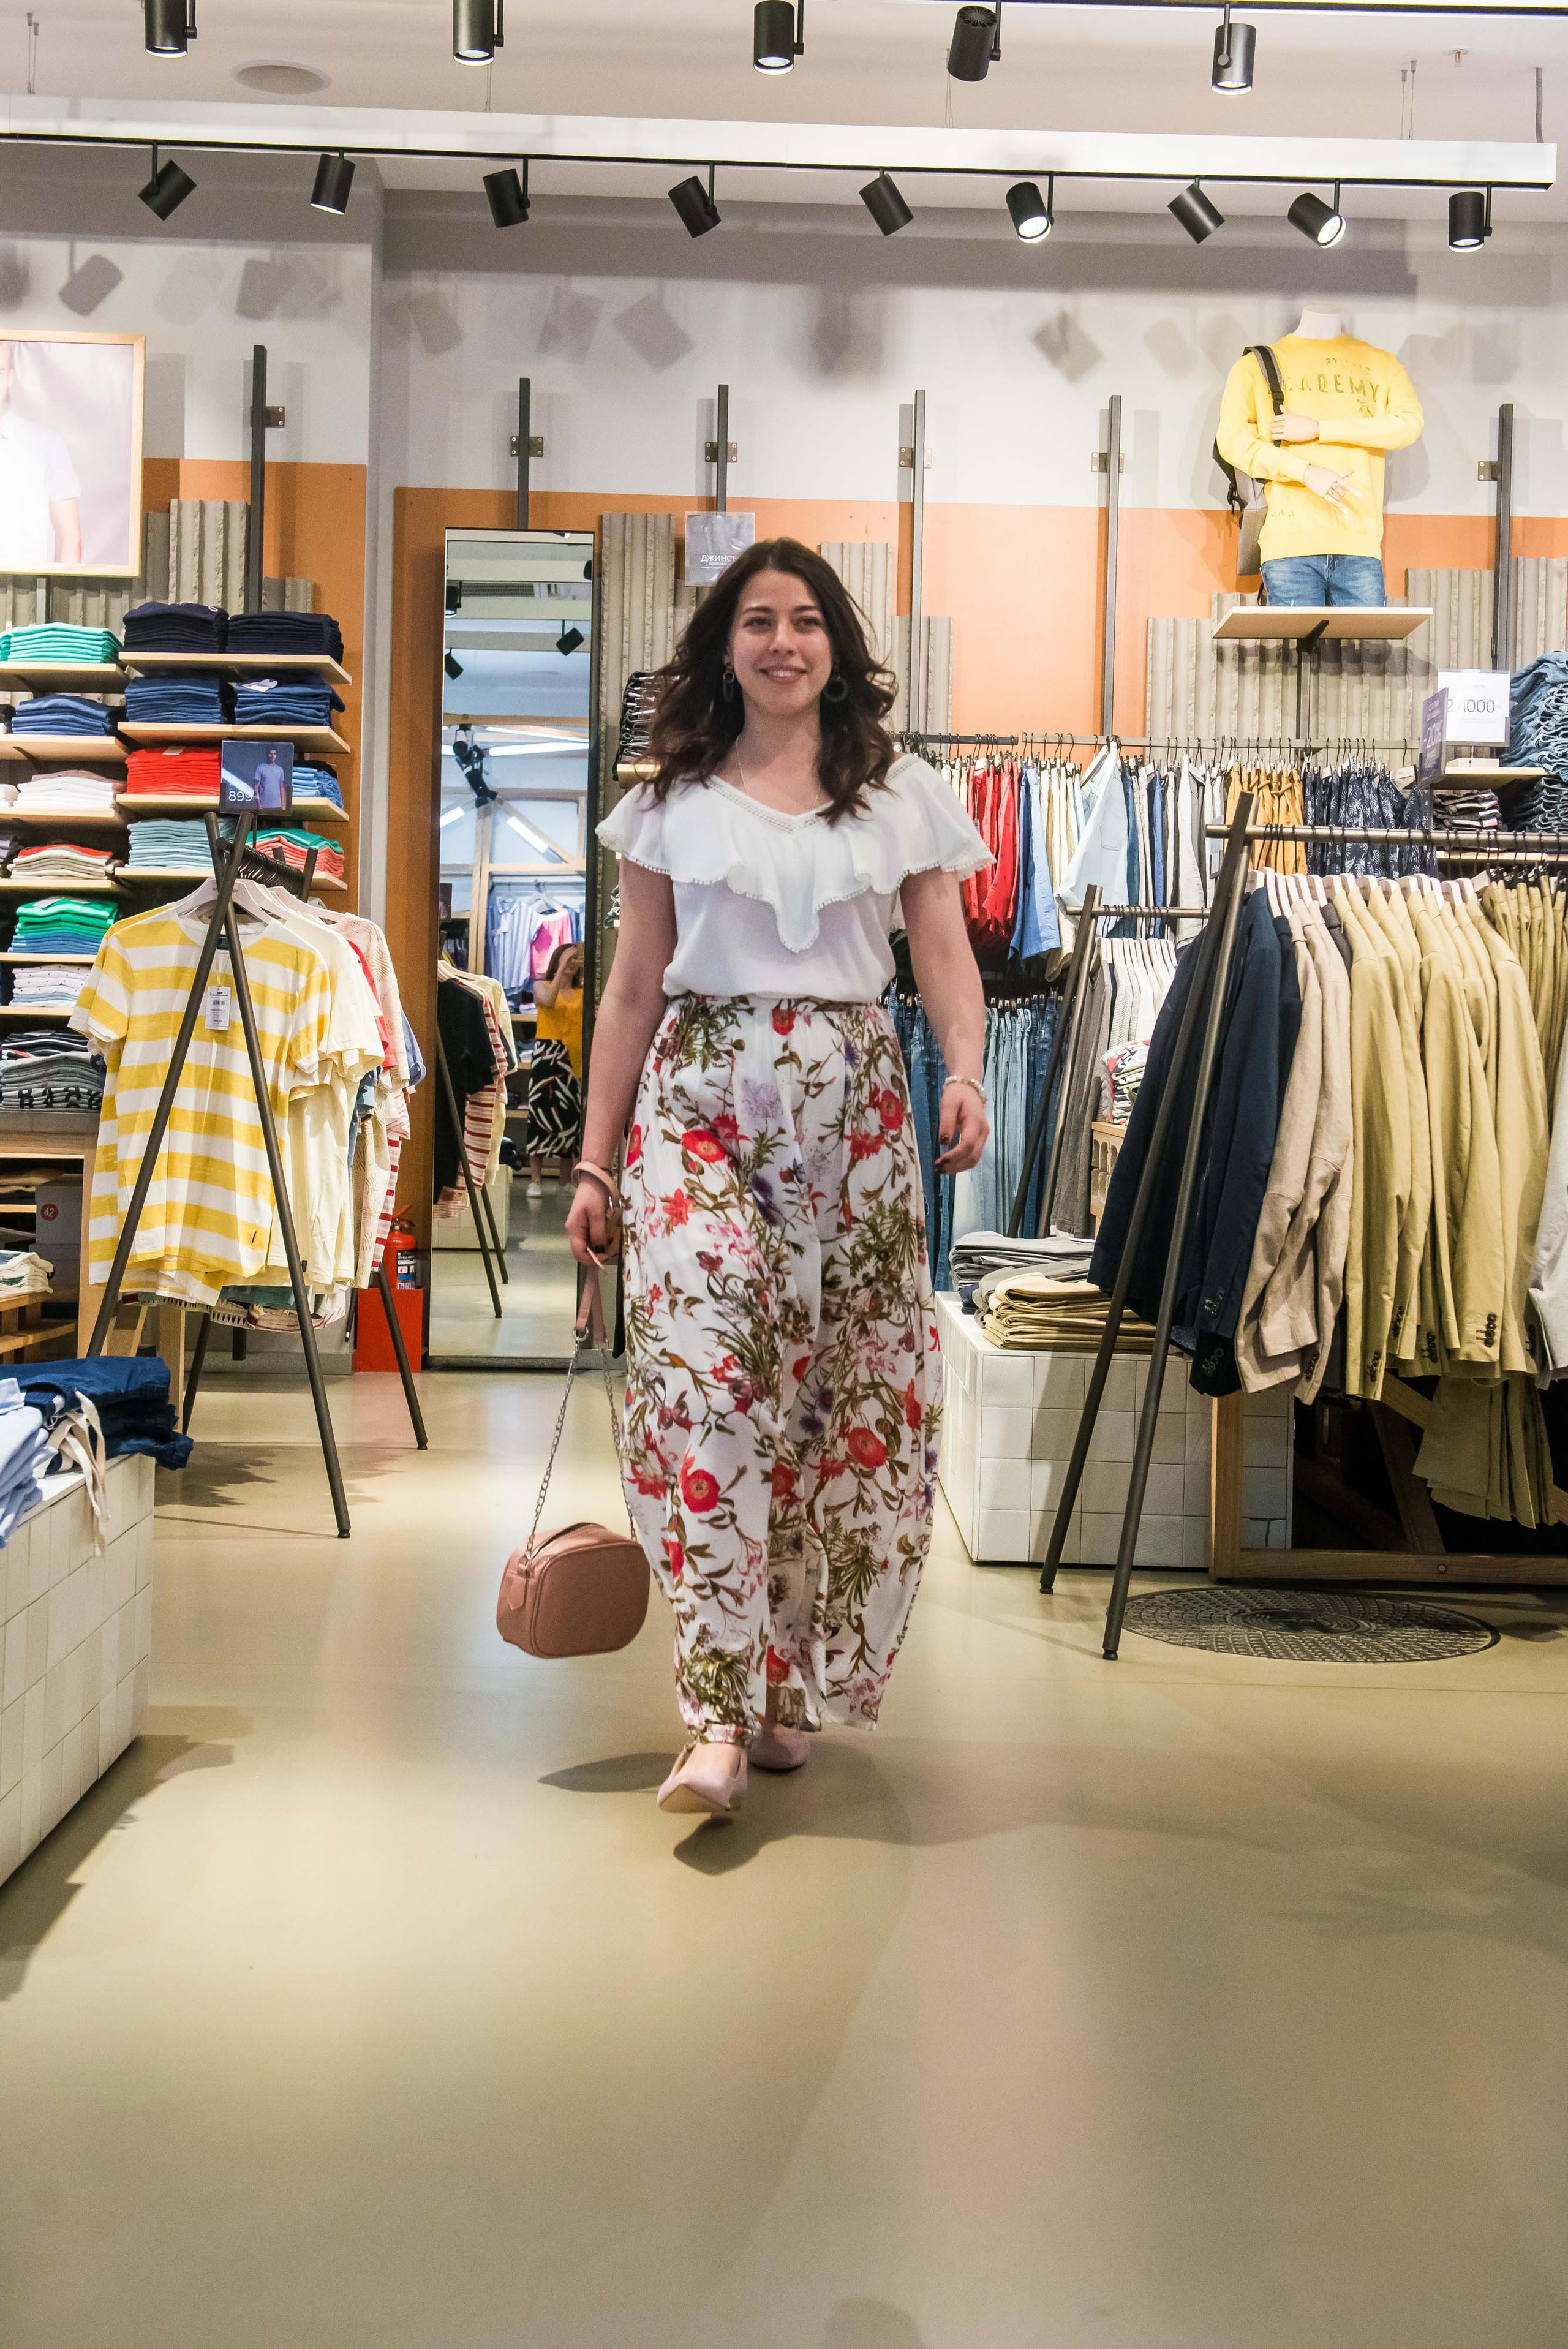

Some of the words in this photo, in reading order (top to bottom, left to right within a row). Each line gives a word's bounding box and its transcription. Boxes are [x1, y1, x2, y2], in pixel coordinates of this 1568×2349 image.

[1272, 372, 1380, 403] CADEMY
[228, 791, 254, 802] 899
[43, 1207, 55, 1218] 42
